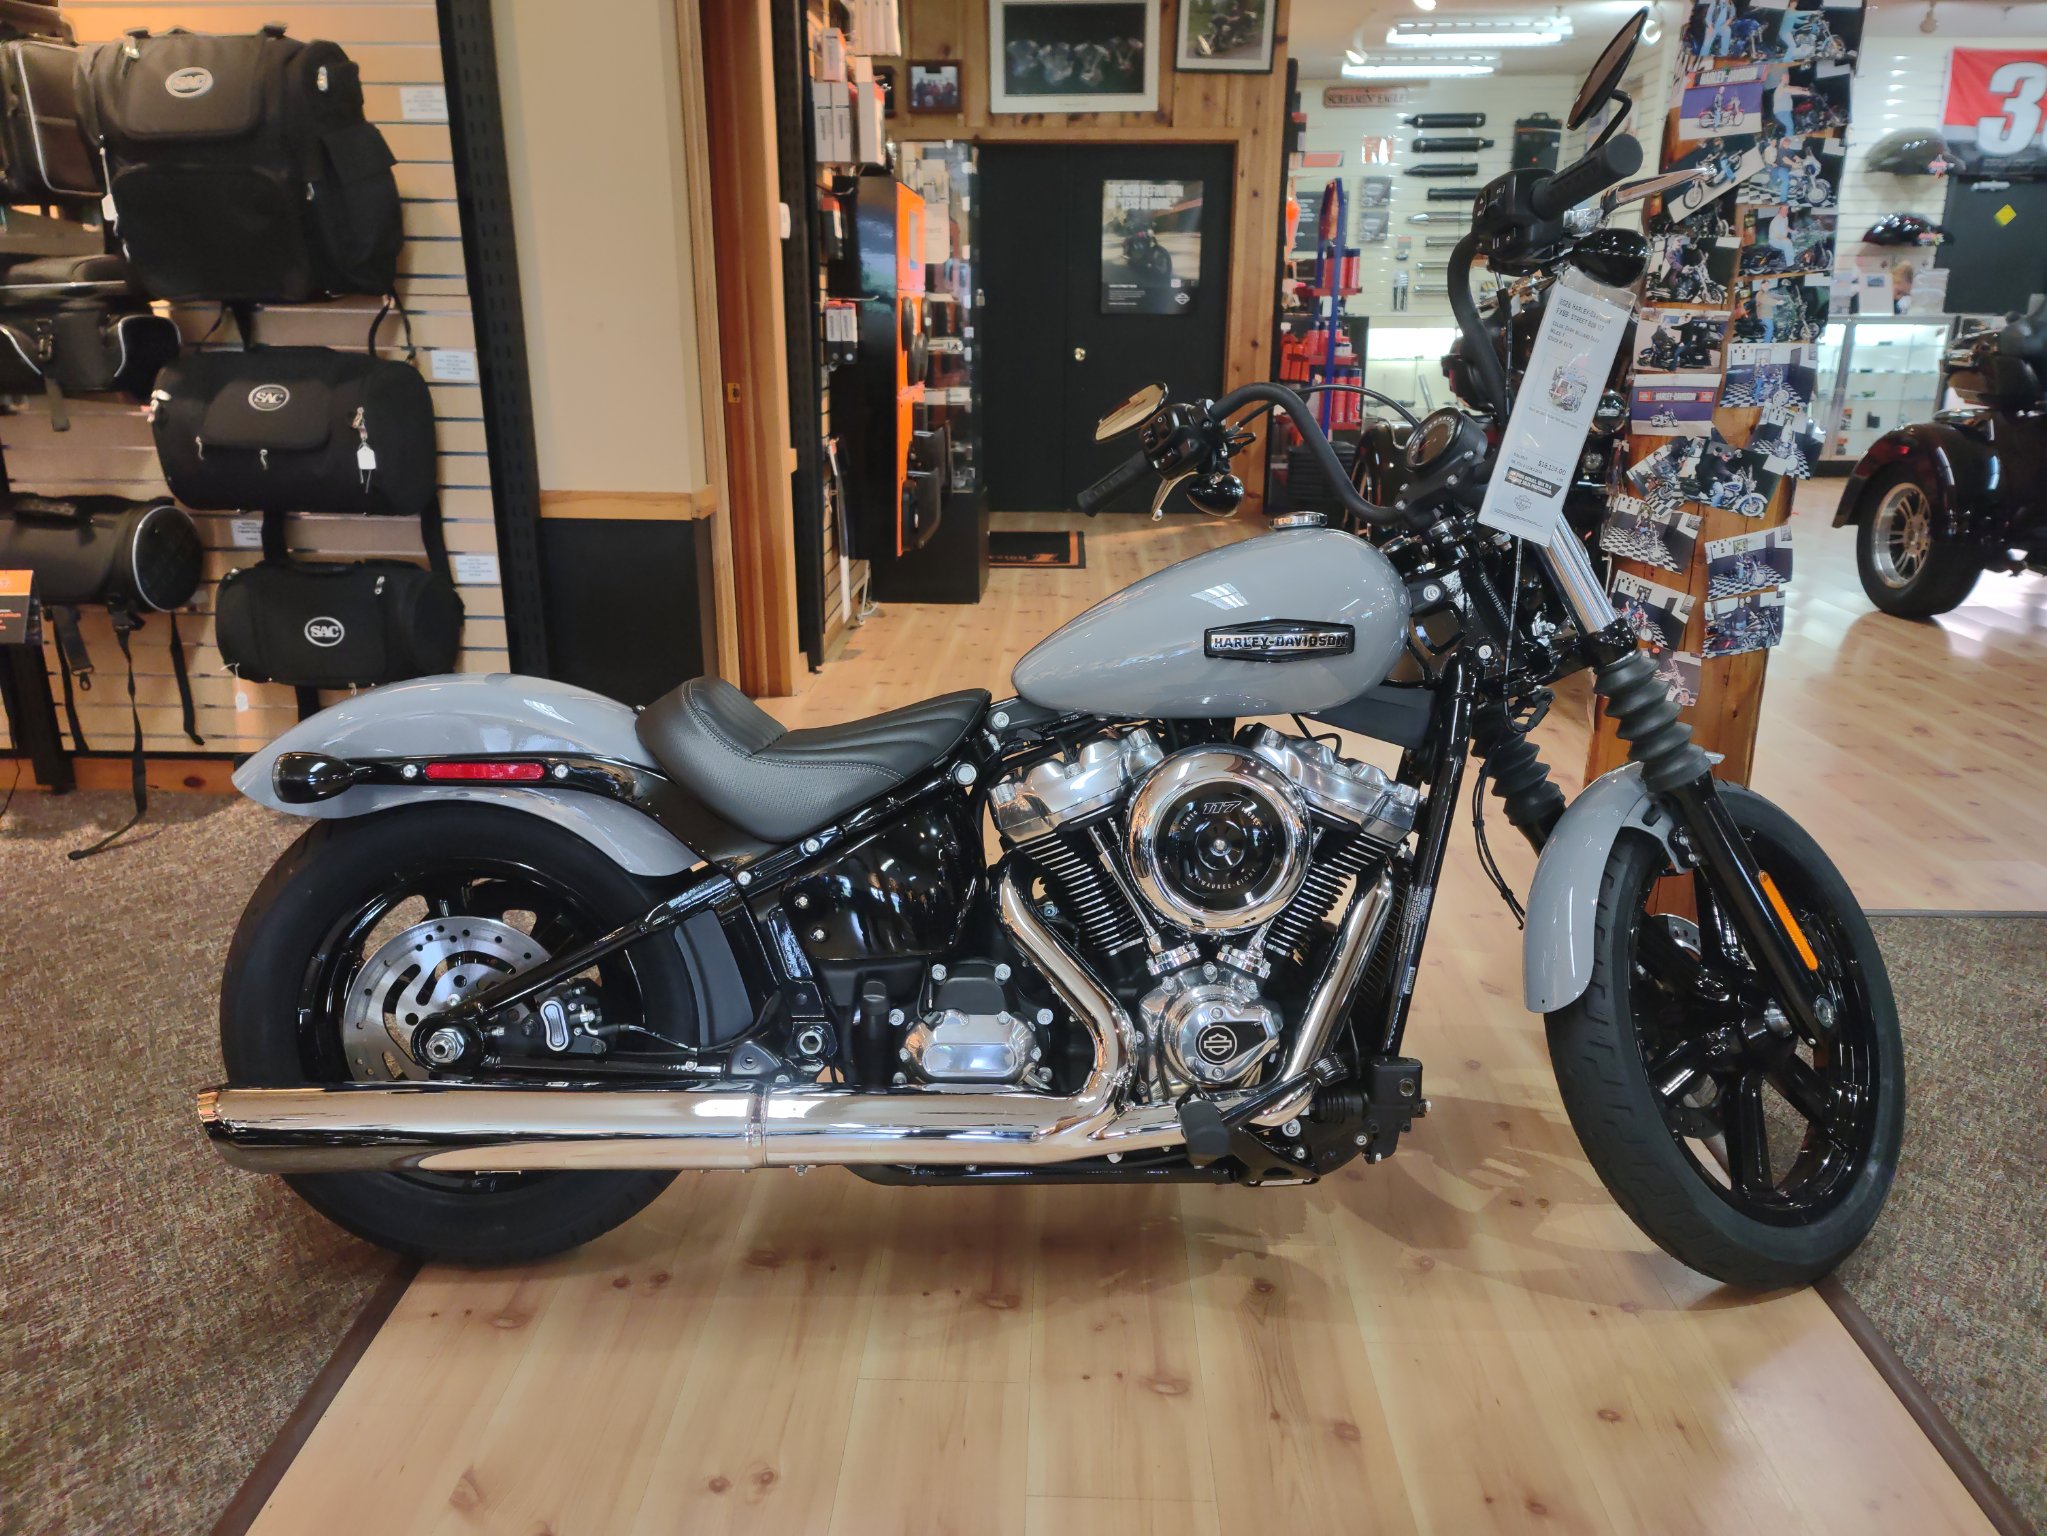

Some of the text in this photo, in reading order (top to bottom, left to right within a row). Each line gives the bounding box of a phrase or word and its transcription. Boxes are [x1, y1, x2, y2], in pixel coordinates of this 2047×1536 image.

[1976, 60, 2047, 157] 3
[253, 391, 284, 404] SAC
[310, 625, 340, 638] SAC
[1213, 634, 1348, 650] HARLEY-DAVIDSON
[1202, 800, 1243, 815] 117
[1180, 810, 1198, 830] CUBIC
